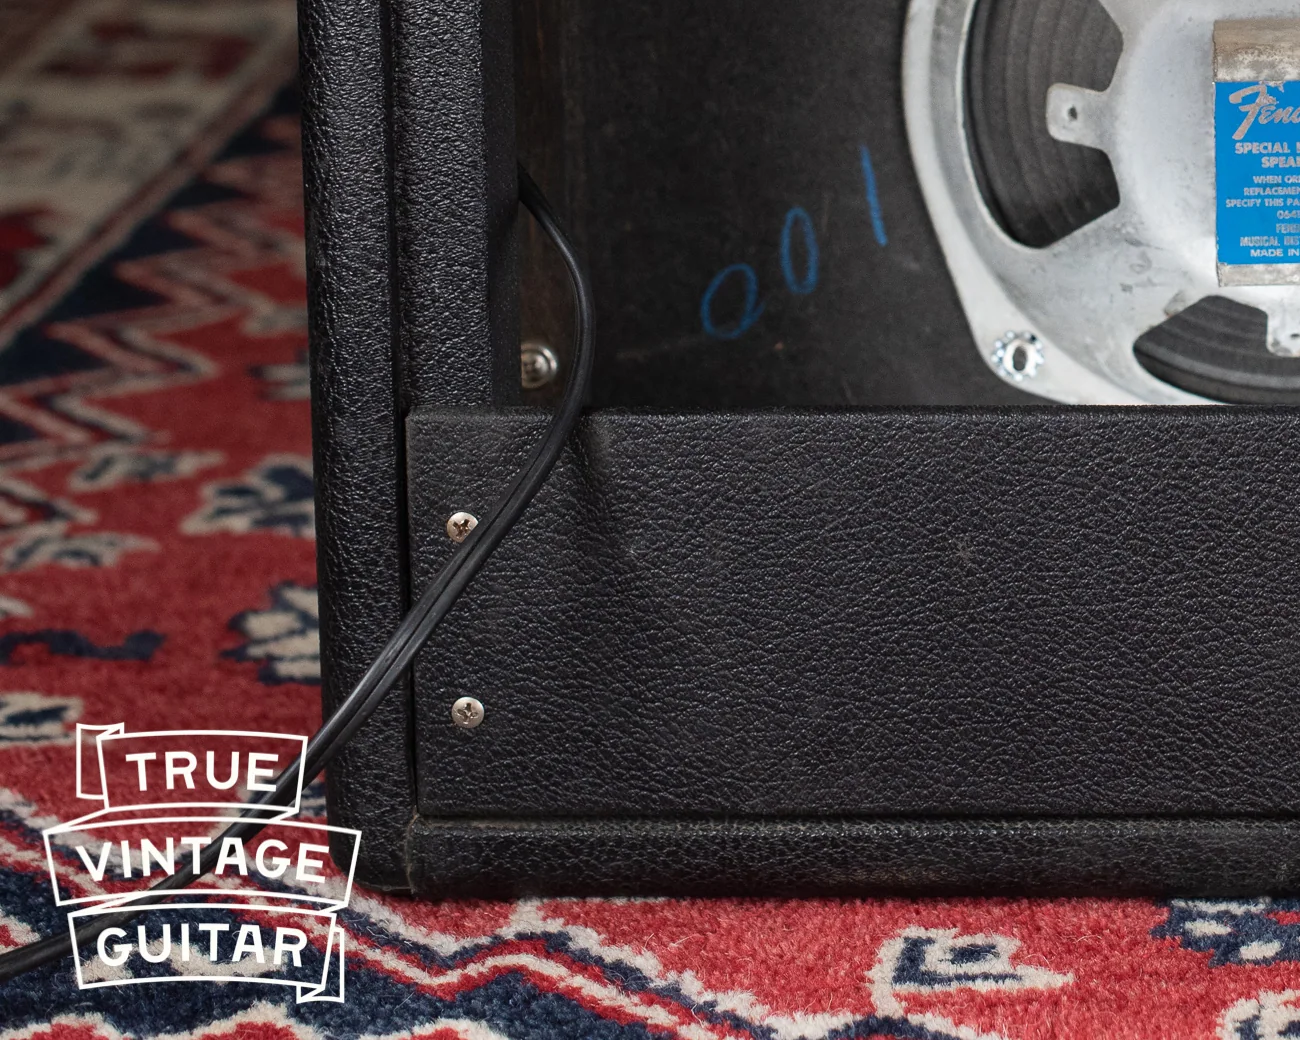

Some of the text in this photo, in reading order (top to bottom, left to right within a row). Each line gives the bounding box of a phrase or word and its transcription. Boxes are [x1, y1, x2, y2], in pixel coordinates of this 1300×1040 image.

[1235, 142, 1290, 154] SPECIAL
[1253, 175, 1282, 184] WHEN
[1225, 198, 1261, 208] SPECIFY
[1264, 198, 1286, 207] THIS
[1240, 236, 1281, 247] MUSICAL
[1250, 248, 1284, 258] MADE
[1287, 248, 1300, 257] IN
